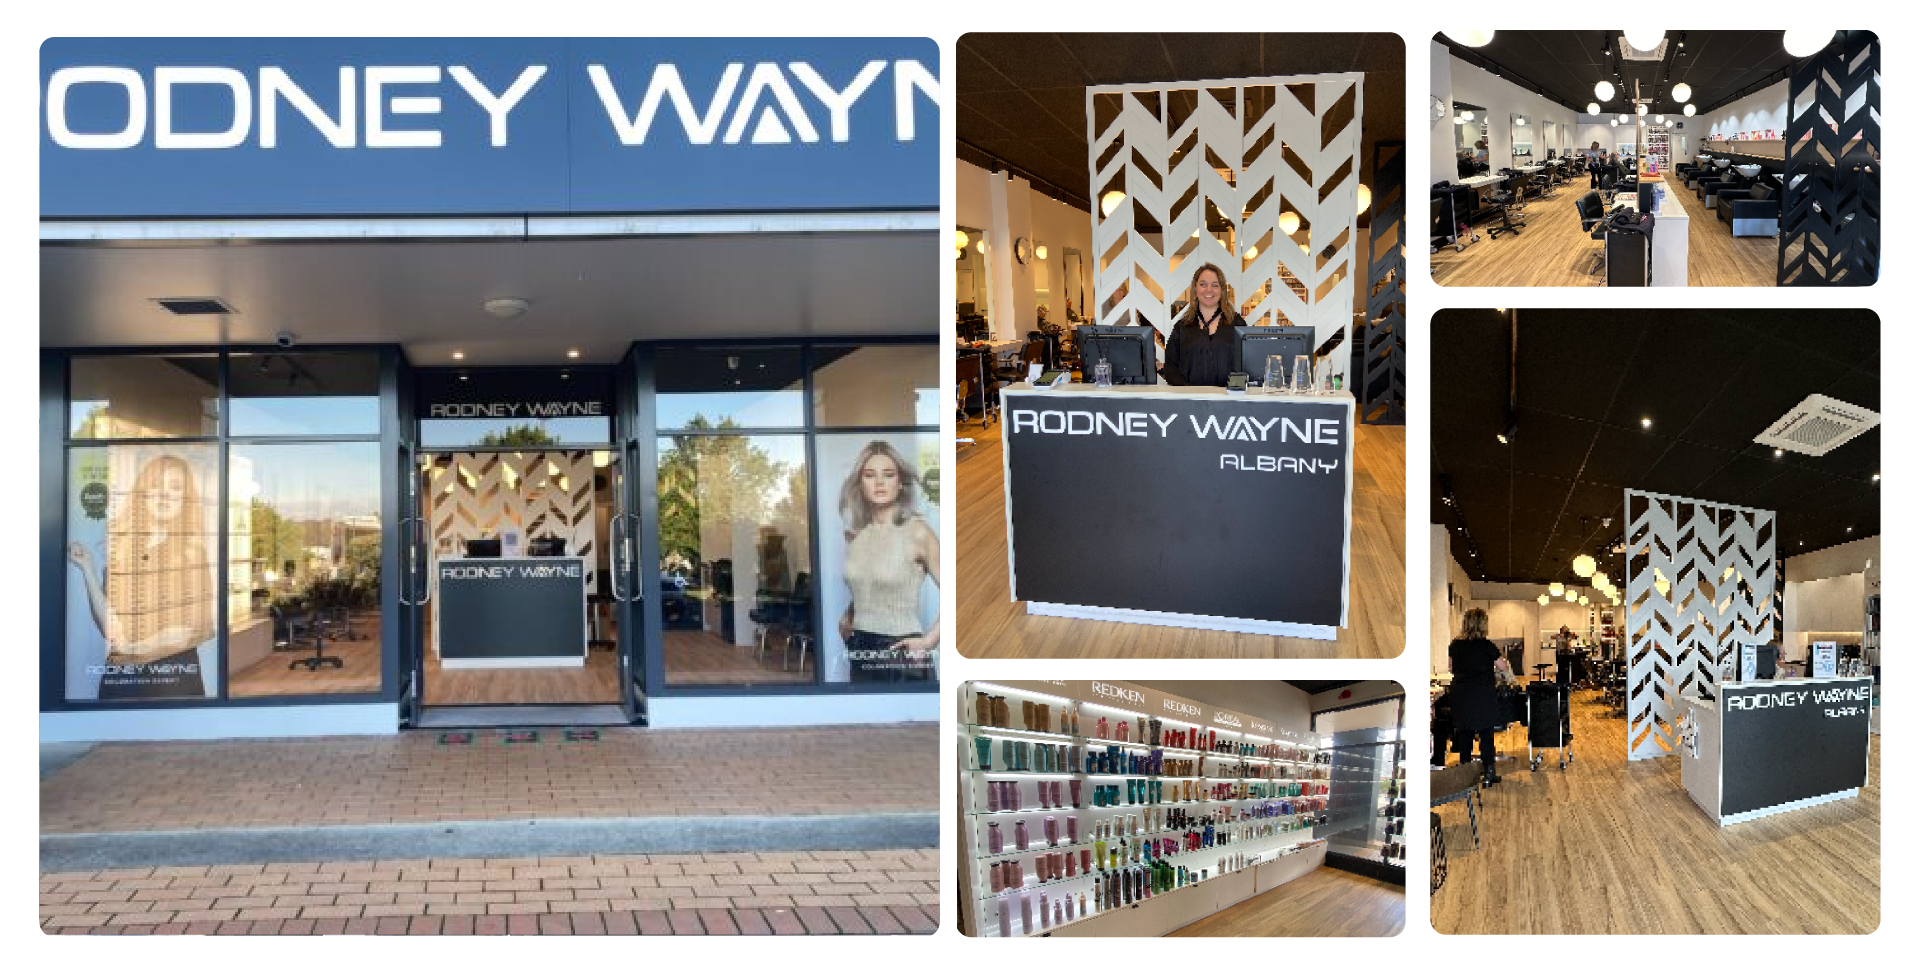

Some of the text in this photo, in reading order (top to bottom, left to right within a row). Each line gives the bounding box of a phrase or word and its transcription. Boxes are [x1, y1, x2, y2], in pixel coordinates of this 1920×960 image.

[431, 401, 602, 416] RODNEY WAYNE
[1012, 409, 1340, 445] RODNEY WAYNE
[1220, 453, 1339, 475] ALBANY
[442, 564, 580, 580] RODNEY WAYNE
[1092, 681, 1145, 704] REDKEN
[1727, 686, 1869, 712] RODNEY WAYNE
[1163, 698, 1201, 716] REDKEN
